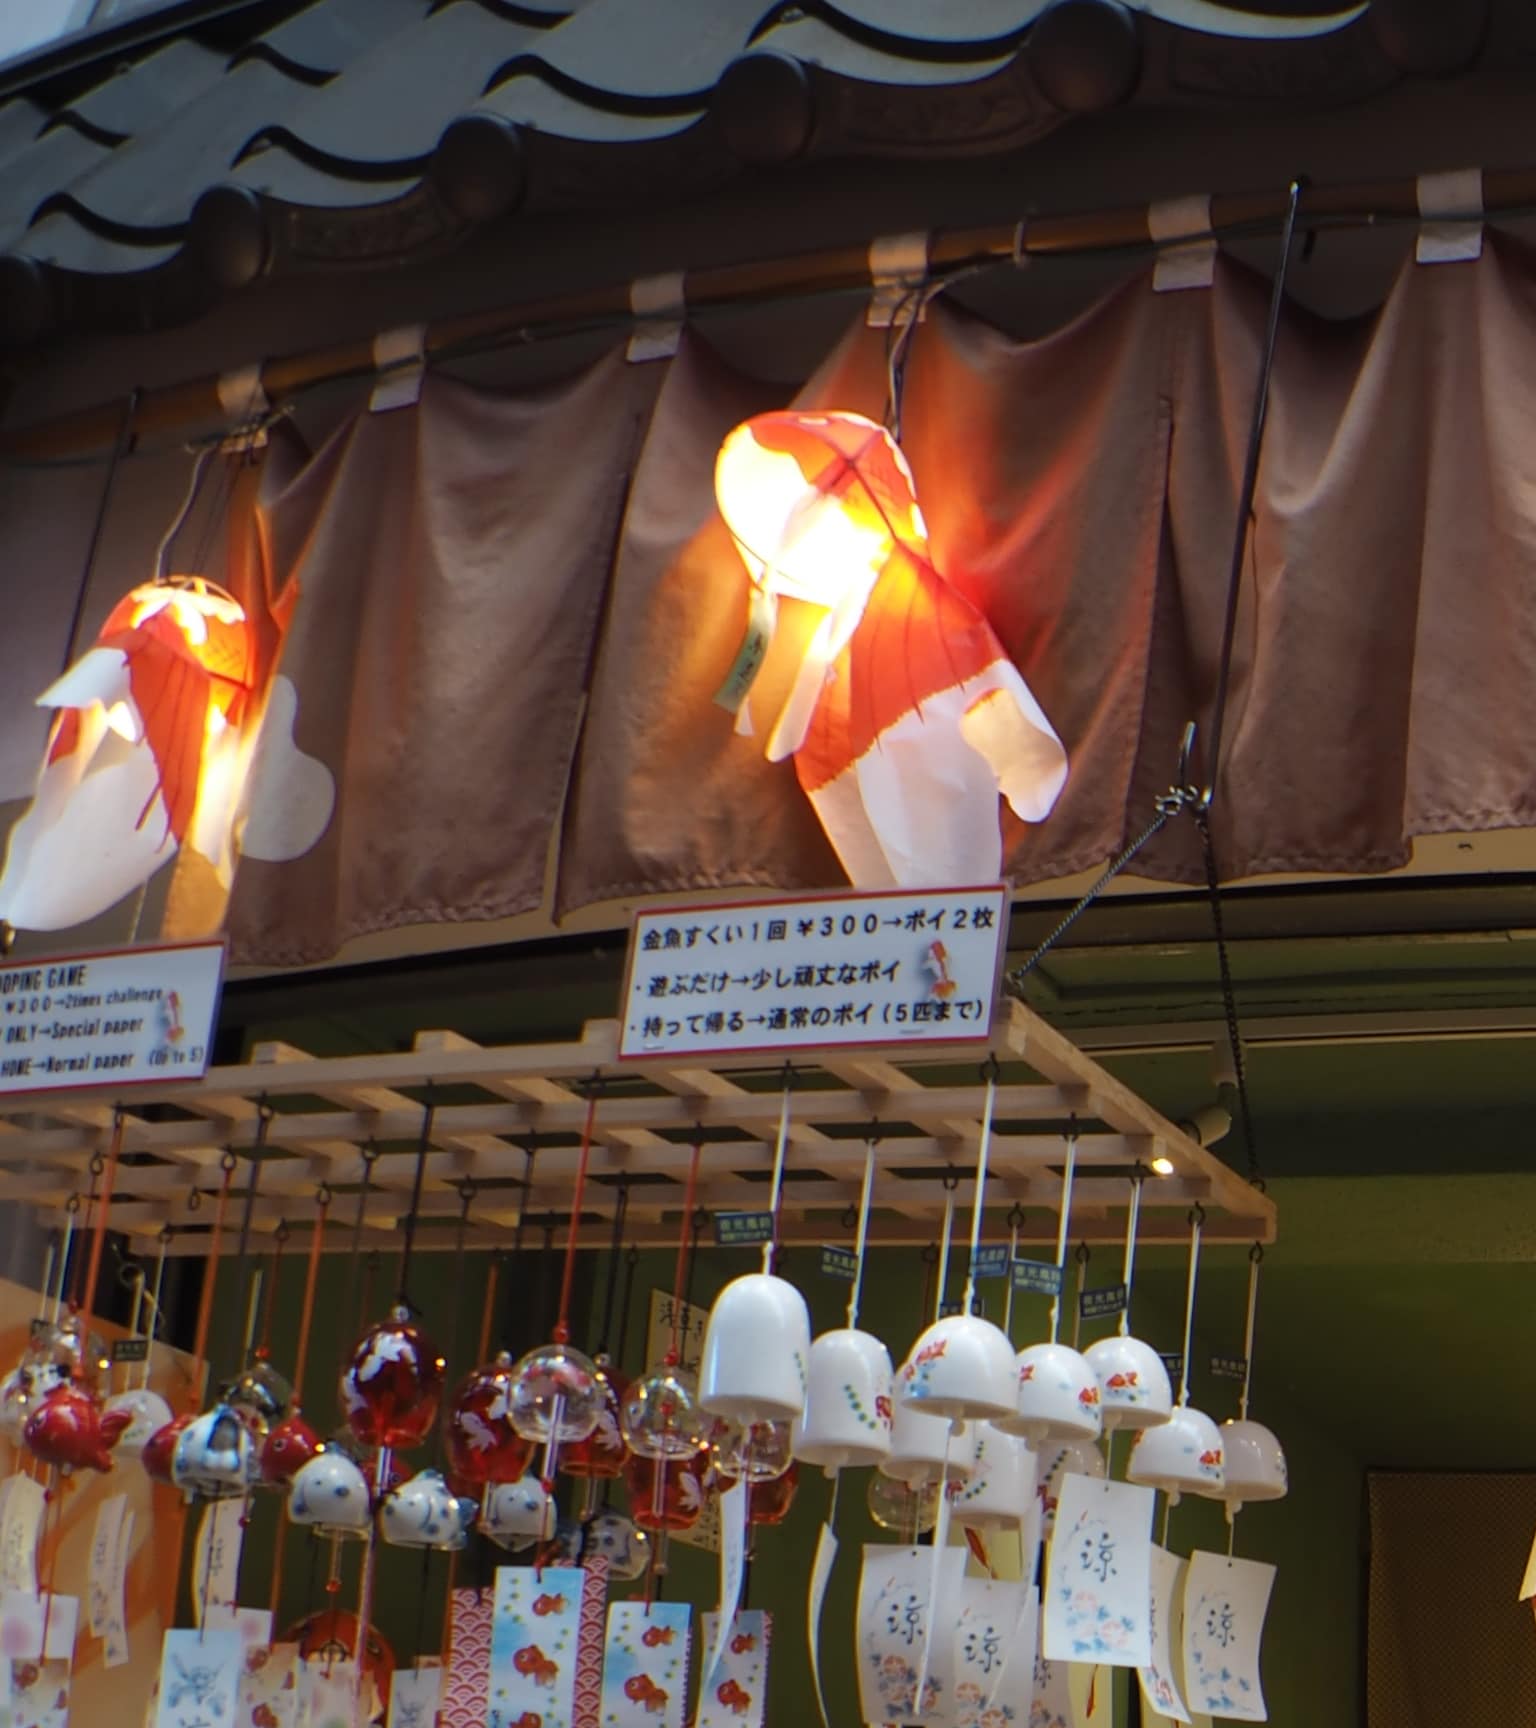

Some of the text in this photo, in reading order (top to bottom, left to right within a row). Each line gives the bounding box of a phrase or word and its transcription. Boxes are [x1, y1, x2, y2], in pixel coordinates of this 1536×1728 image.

[0, 964, 88, 994] OPING GAME
[106, 987, 163, 1005] challenge
[6, 1017, 144, 1044] ONLY Special paper
[45, 1053, 91, 1073] Normal
[93, 1053, 135, 1071] paper
[1080, 1532, 1118, 1582] 涼
[887, 1593, 924, 1645] 涼
[1206, 1602, 1235, 1648] 涼
[964, 1625, 1002, 1674] 涼
